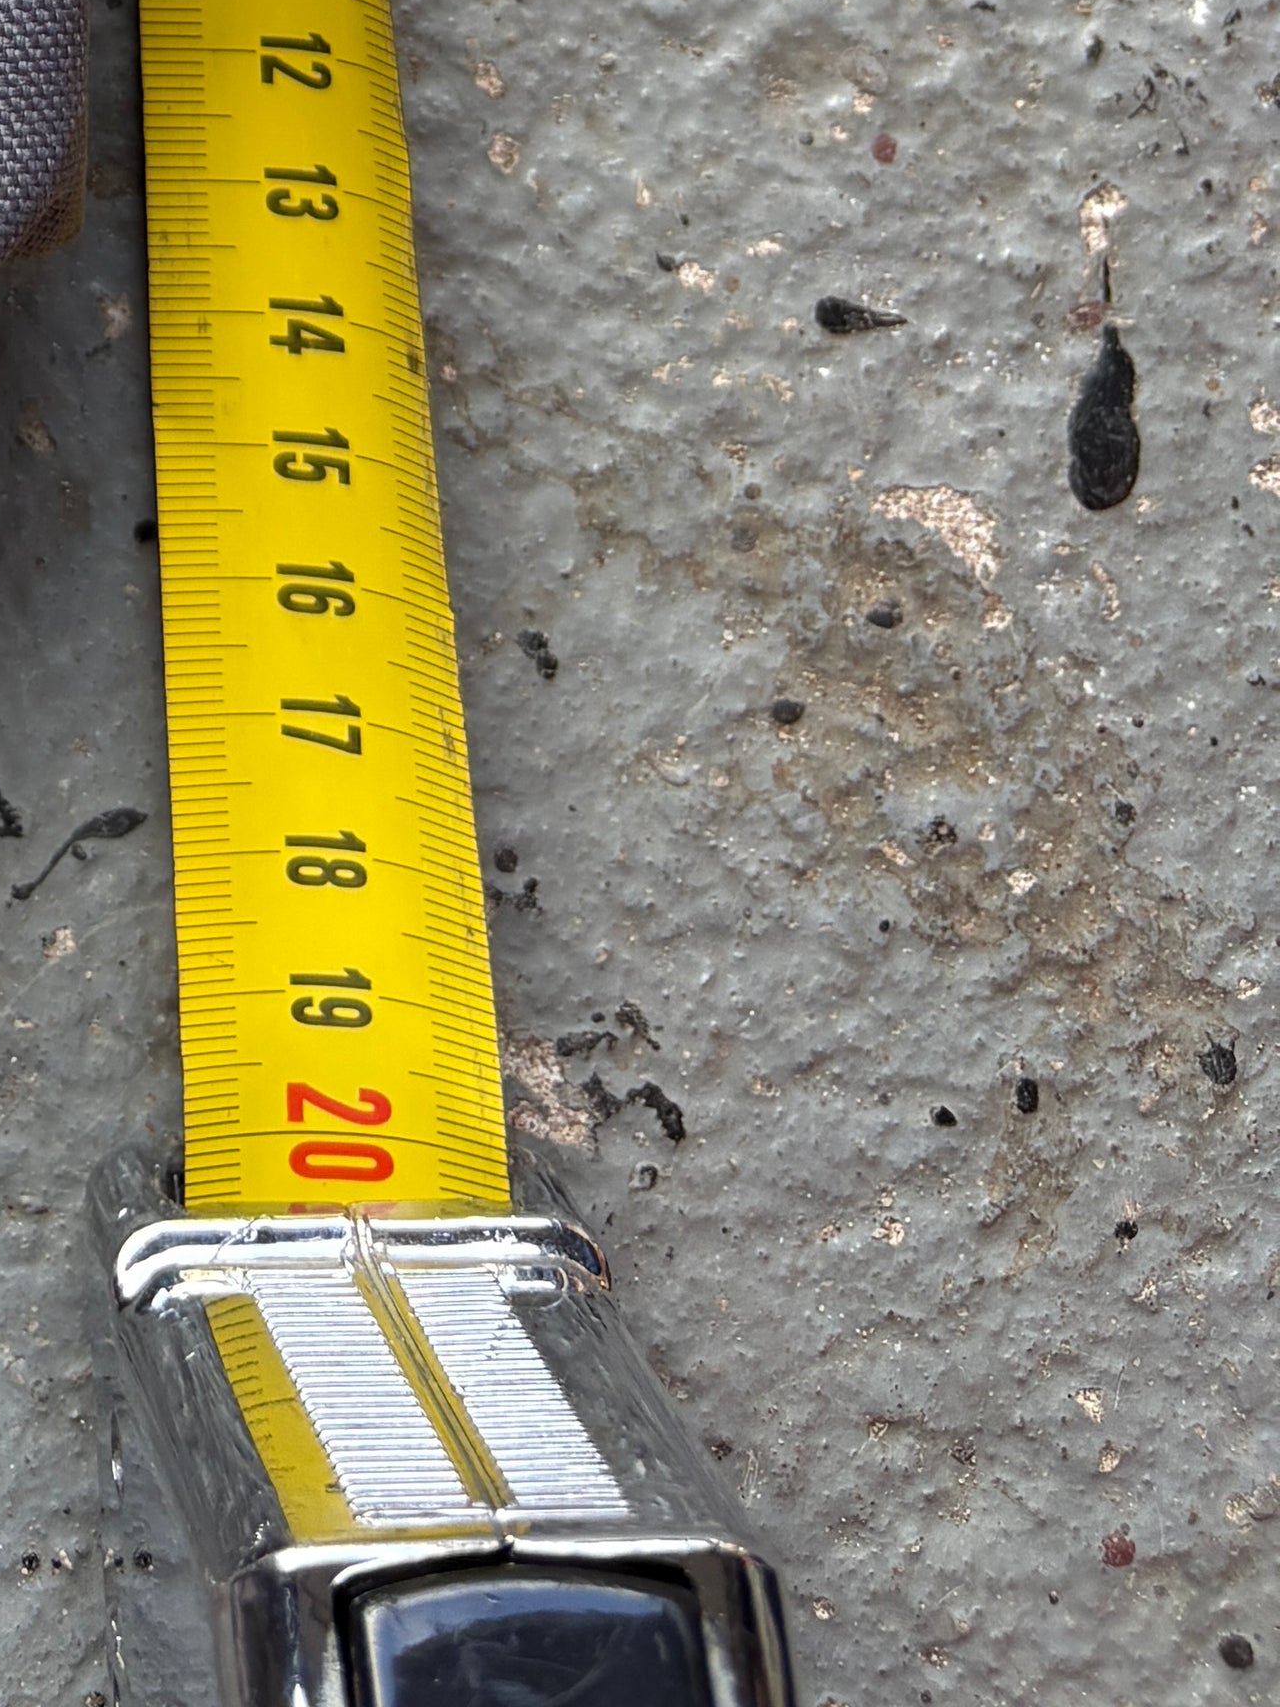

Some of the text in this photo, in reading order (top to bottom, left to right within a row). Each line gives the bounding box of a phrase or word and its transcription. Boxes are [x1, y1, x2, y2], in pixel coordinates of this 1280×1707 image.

[260, 32, 332, 90] 12
[264, 164, 339, 222] 13
[268, 294, 345, 355] 14
[272, 427, 350, 485] 15
[276, 560, 356, 617] 16
[280, 694, 363, 756] 17
[284, 830, 367, 889] 18
[289, 967, 373, 1029] 19
[287, 1082, 395, 1183] 20
